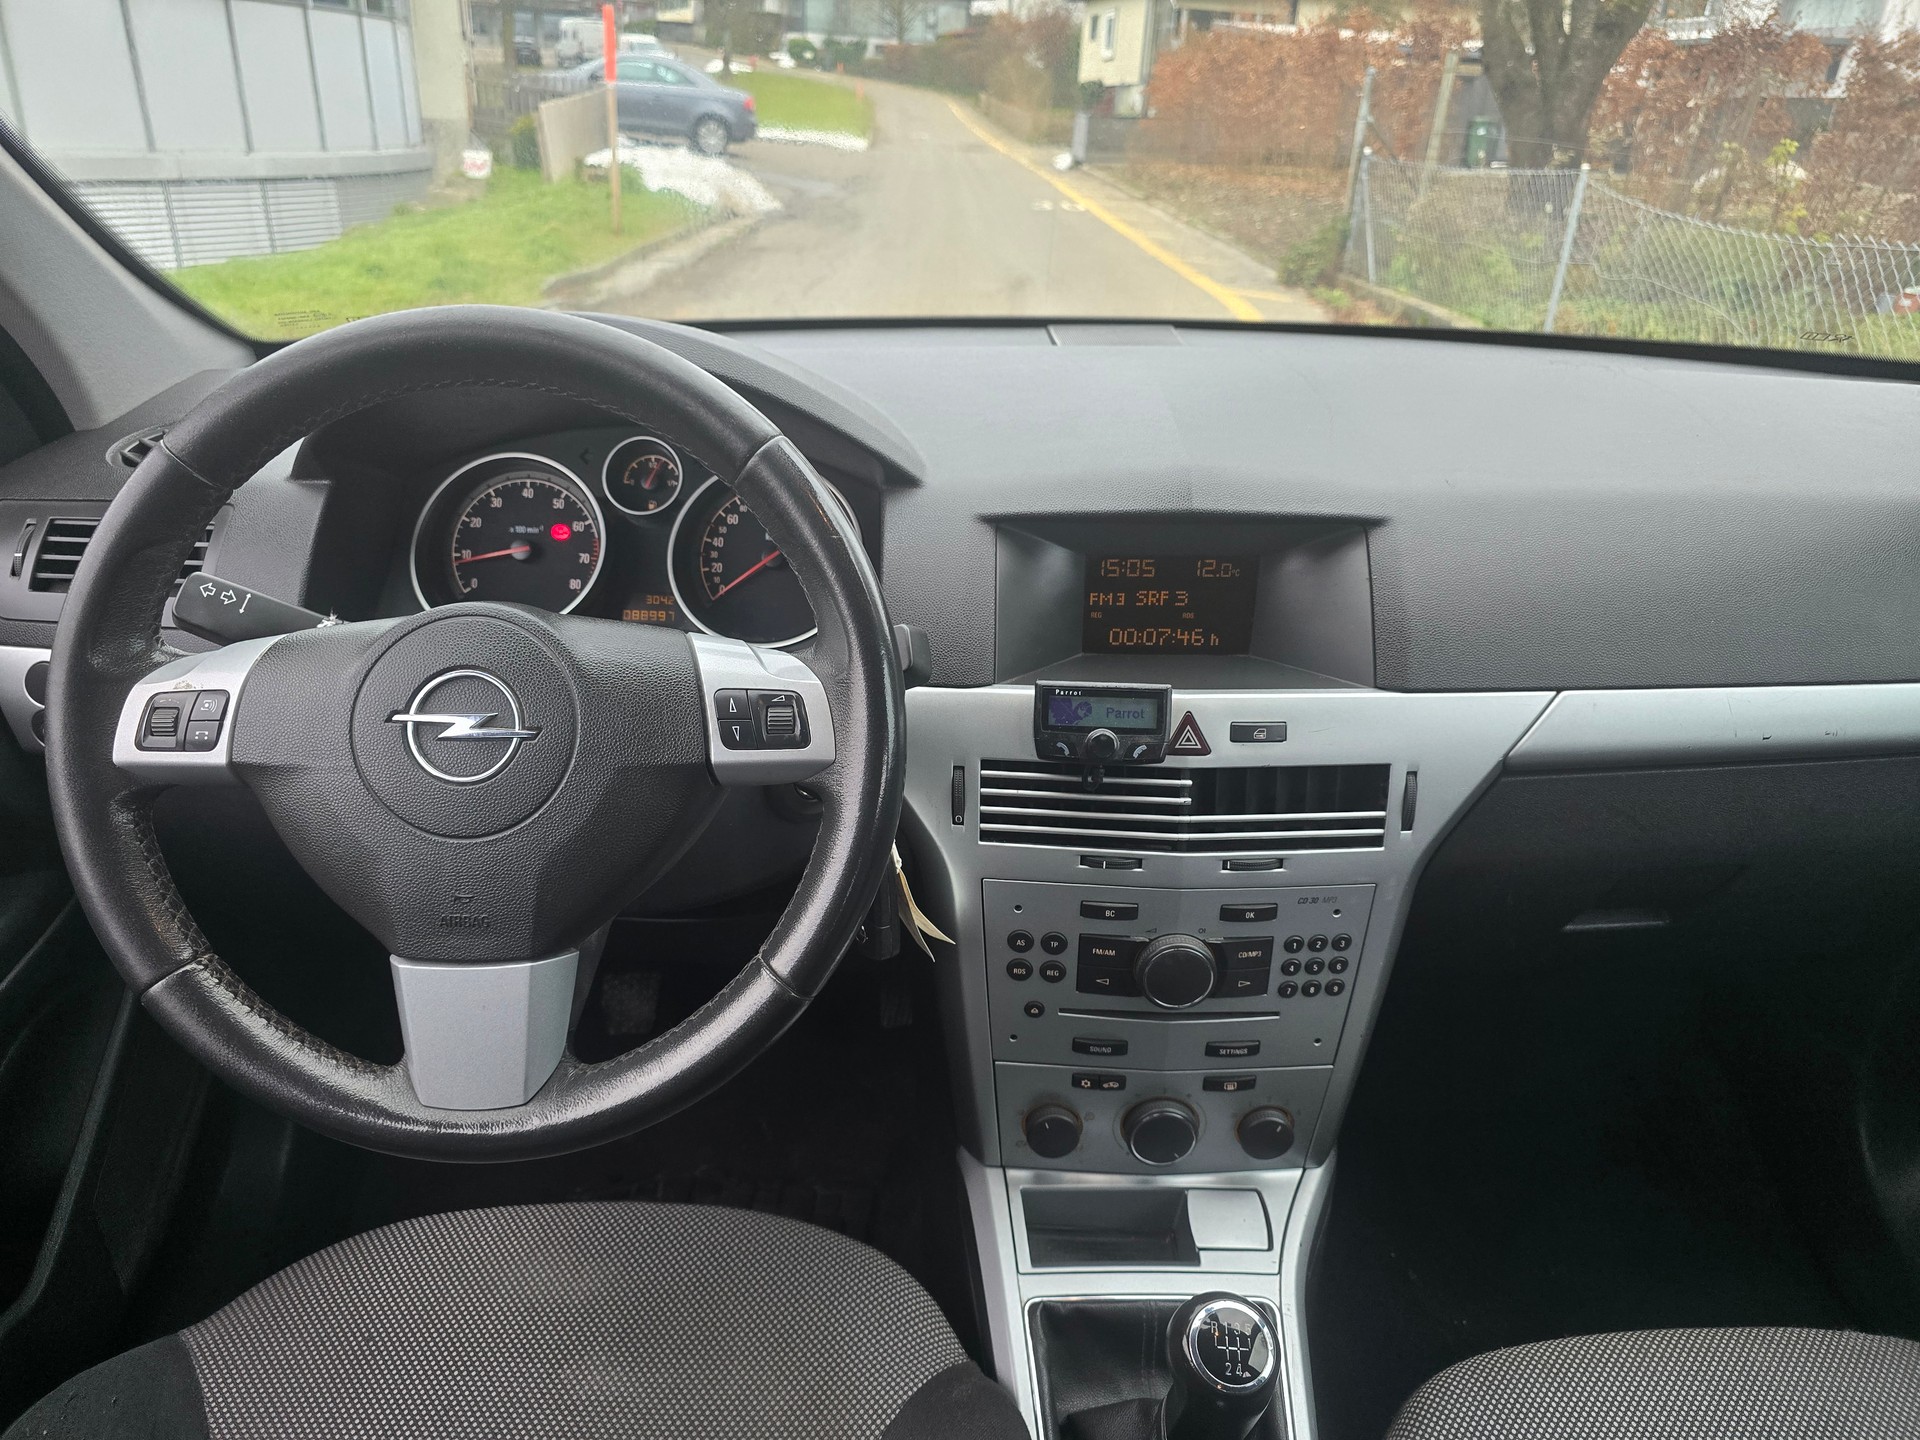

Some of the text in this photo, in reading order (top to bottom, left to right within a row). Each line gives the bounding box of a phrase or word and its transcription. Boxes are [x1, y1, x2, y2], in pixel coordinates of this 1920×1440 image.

[522, 488, 534, 499] 40
[490, 498, 502, 508] 30
[553, 499, 565, 510] 50
[470, 517, 482, 528] 20
[727, 514, 739, 525] 60
[572, 521, 585, 532] 60
[719, 526, 728, 534] 50
[712, 537, 724, 548] 40
[462, 550, 472, 560] 10
[579, 553, 590, 564] 70
[710, 551, 719, 559] 30
[711, 563, 723, 573] 20
[1101, 559, 1156, 577] 15:05
[470, 578, 478, 589] 0
[569, 579, 582, 590] 80
[713, 576, 721, 584] 10
[1136, 590, 1169, 606] SRF
[1174, 590, 1189, 606] 3
[623, 609, 675, 621] 088997
[1090, 611, 1102, 619] REG
[1109, 628, 1219, 646] 00:07:46 h
[1055, 688, 1082, 696] Parrot
[1106, 706, 1145, 719] Parrot
[1297, 896, 1309, 905] CD
[1309, 896, 1320, 905] 30
[1105, 909, 1116, 918] BC
[1245, 911, 1255, 919] OK
[1016, 939, 1026, 947] AS
[1050, 941, 1059, 949] TP
[1292, 942, 1298, 950] 1
[1315, 941, 1322, 949] 2
[1339, 940, 1346, 948] 3
[1092, 948, 1116, 957] FM/AM
[1238, 950, 1262, 959] CD/MP3
[1288, 965, 1295, 973] 4
[1312, 964, 1319, 972] 5
[1336, 963, 1342, 971] 6
[1046, 969, 1060, 977] REG
[1286, 987, 1292, 995] 7
[1309, 986, 1316, 994] 8
[1332, 985, 1339, 993] 9
[1089, 1045, 1112, 1053] SOUND
[1219, 1047, 1248, 1055] SETTINGS
[1210, 1321, 1218, 1335] R
[1225, 1362, 1243, 1377] 2 4
